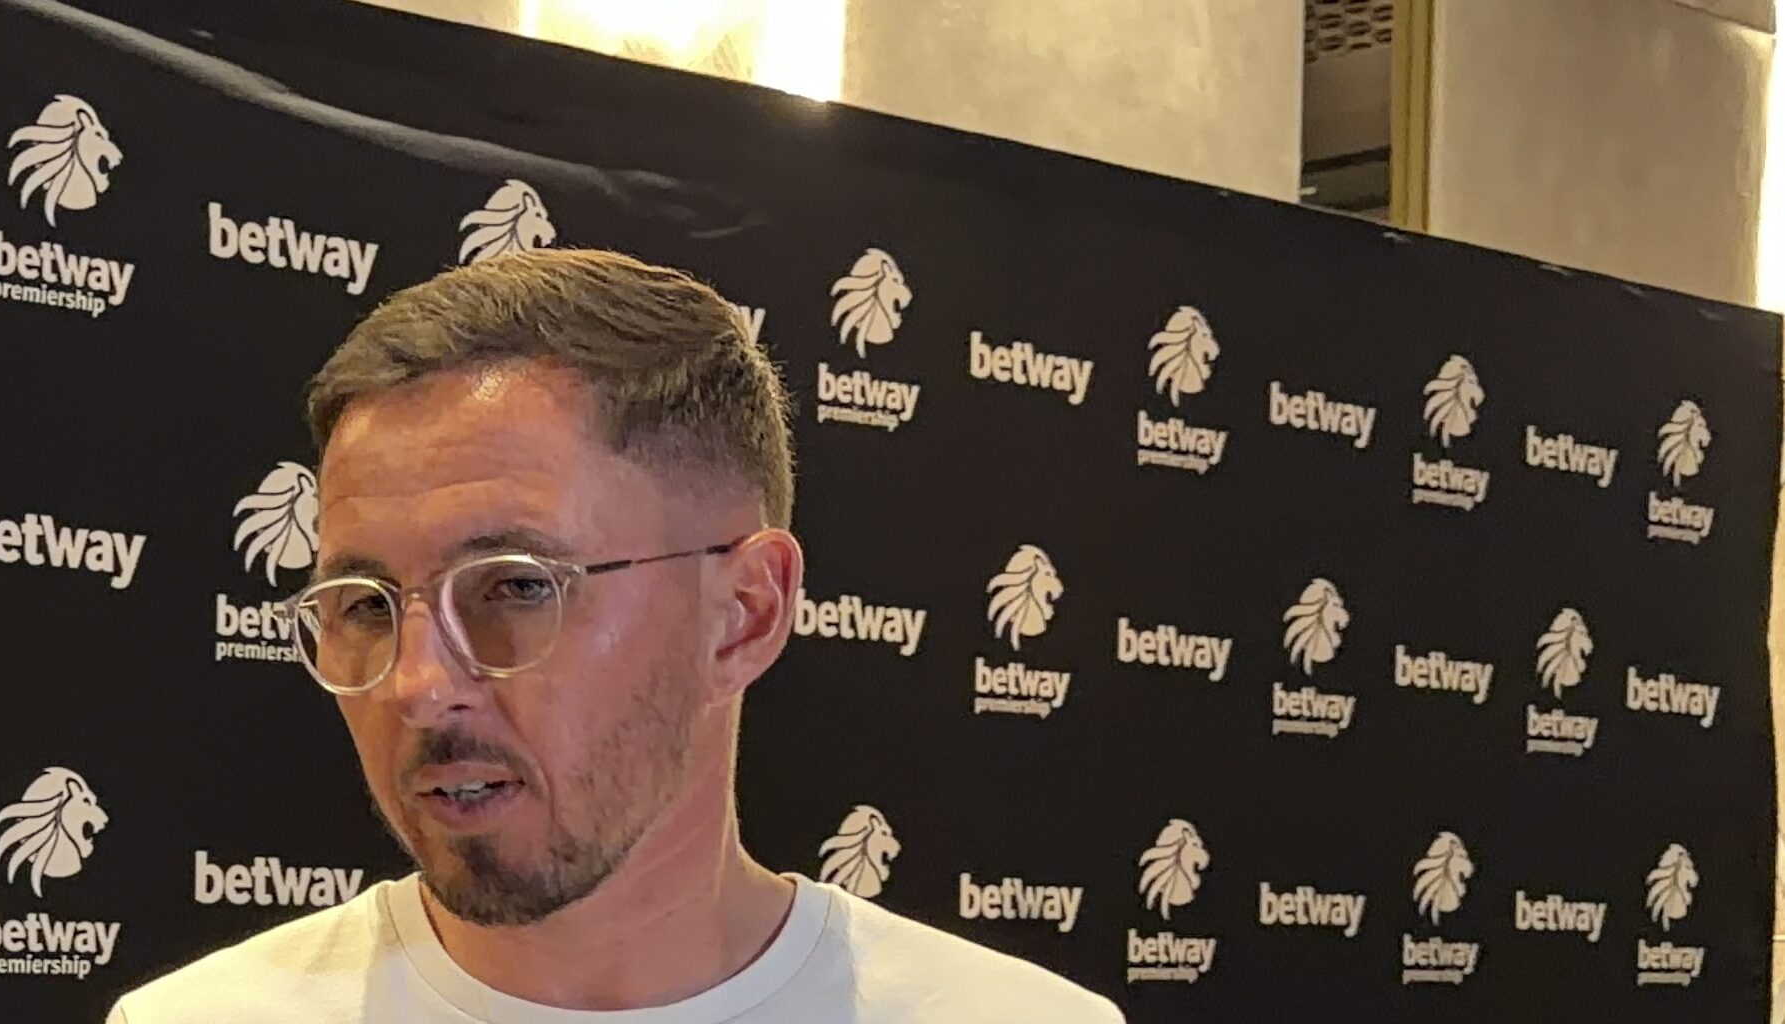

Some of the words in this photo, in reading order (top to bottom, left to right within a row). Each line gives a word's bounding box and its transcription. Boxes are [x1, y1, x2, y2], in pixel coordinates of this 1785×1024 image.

[208, 202, 379, 296] betway
[817, 363, 921, 422] betway
[969, 331, 1092, 405] betway
[1137, 411, 1227, 465] betway
[1269, 381, 1377, 448] betway
[1413, 453, 1490, 503] betway
[1526, 426, 1618, 488] betway
[1648, 492, 1714, 538] betway
[795, 590, 926, 656] betway
[1117, 617, 1233, 682] betway
[975, 656, 1070, 708] betway
[1395, 645, 1494, 705] betway
[1626, 667, 1721, 728] betway
[1272, 683, 1356, 730] betway
[1526, 704, 1598, 749] betway
[195, 850, 363, 906] betway
[959, 873, 1083, 933] betway
[1259, 883, 1366, 937] betway
[1515, 891, 1607, 943] betway
[1127, 929, 1216, 973] betway
[1402, 934, 1479, 974] betway
[1638, 939, 1704, 976] betway
